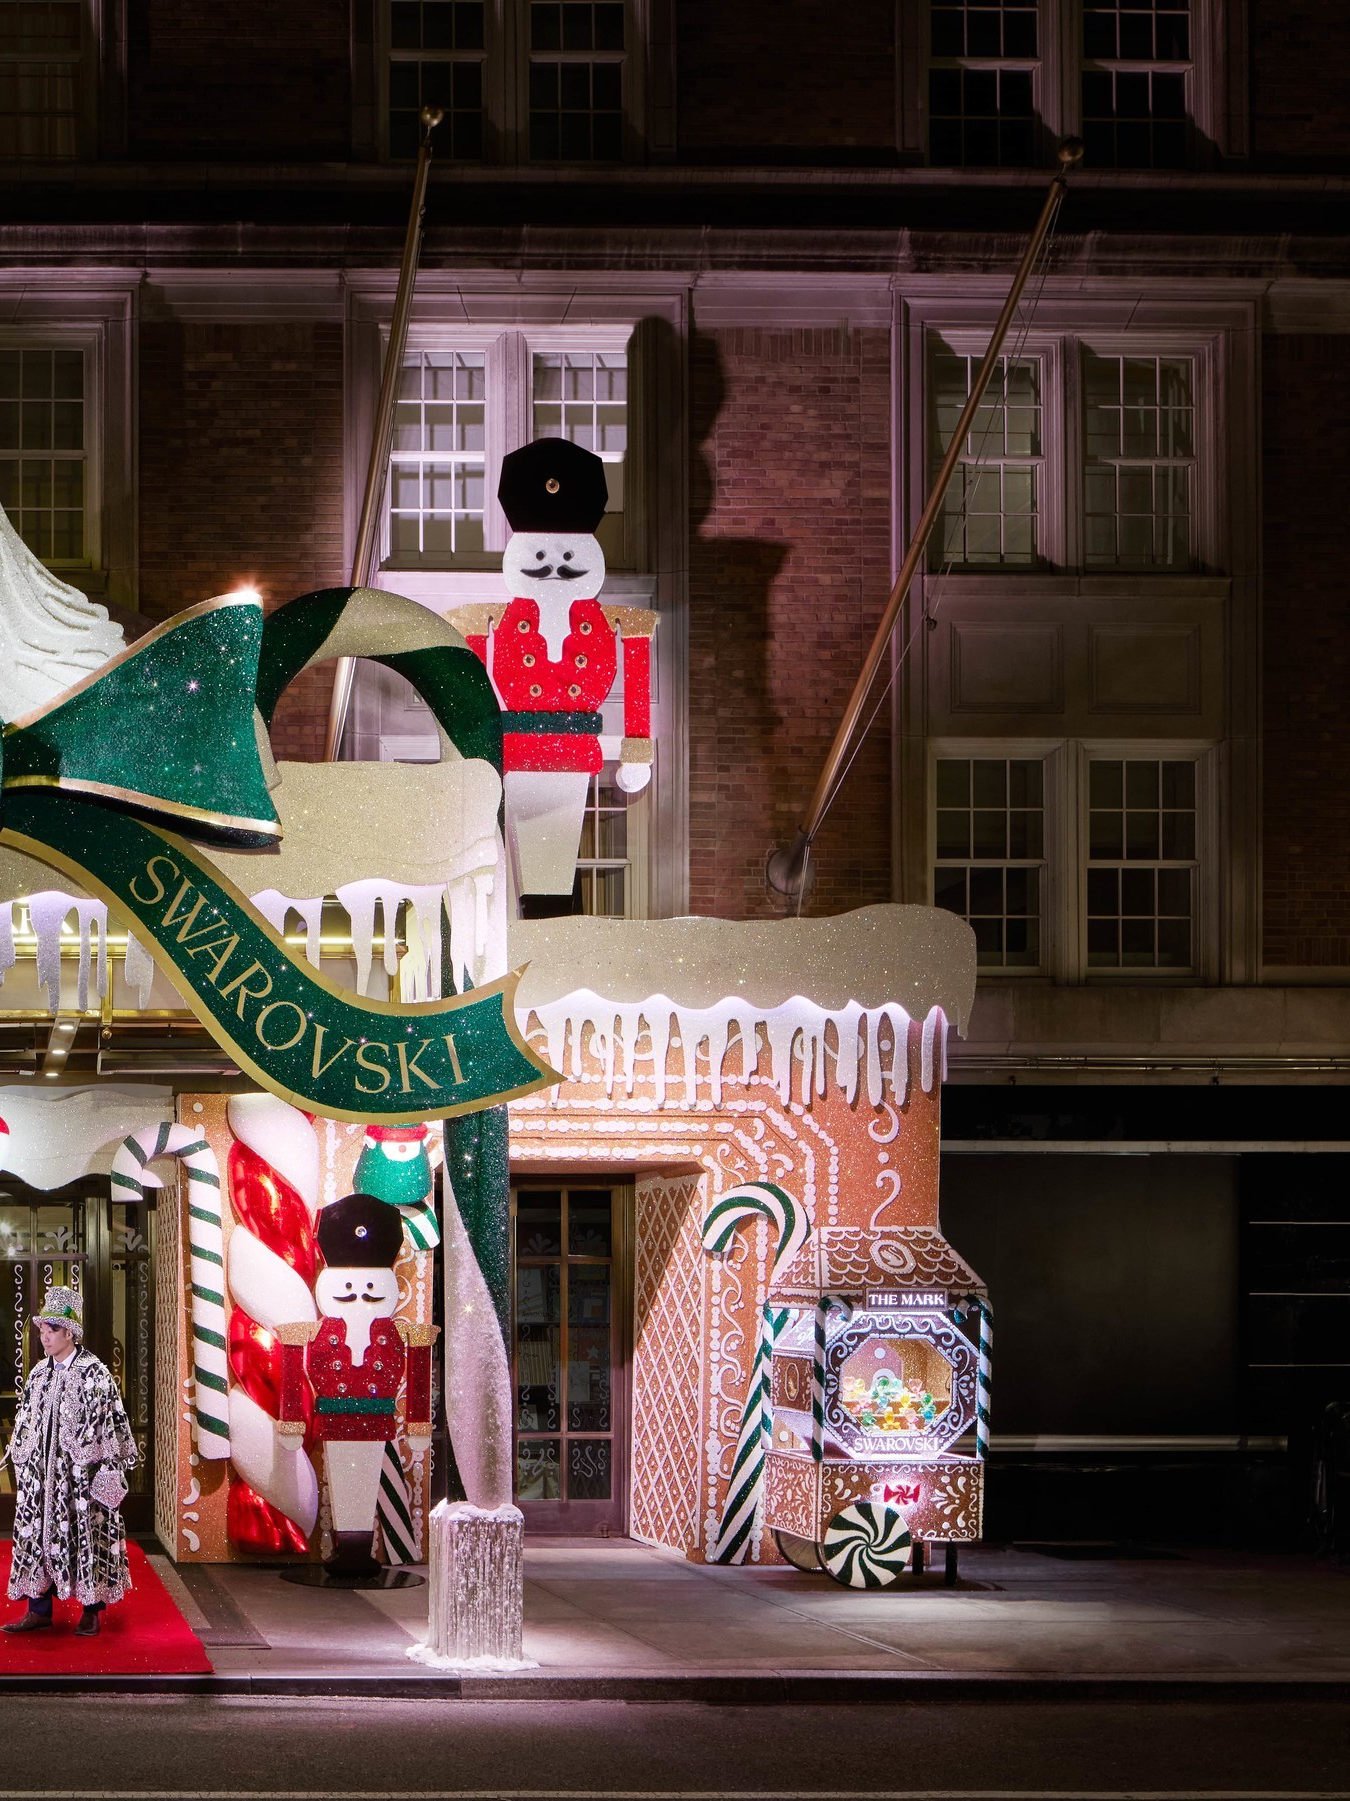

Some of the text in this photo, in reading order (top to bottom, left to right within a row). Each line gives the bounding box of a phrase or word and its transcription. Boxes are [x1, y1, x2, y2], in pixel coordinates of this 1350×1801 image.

[128, 855, 470, 1095] SWAROVSKI
[868, 1293, 945, 1306] THE MARK
[854, 1437, 939, 1452] SWAROVSKI
